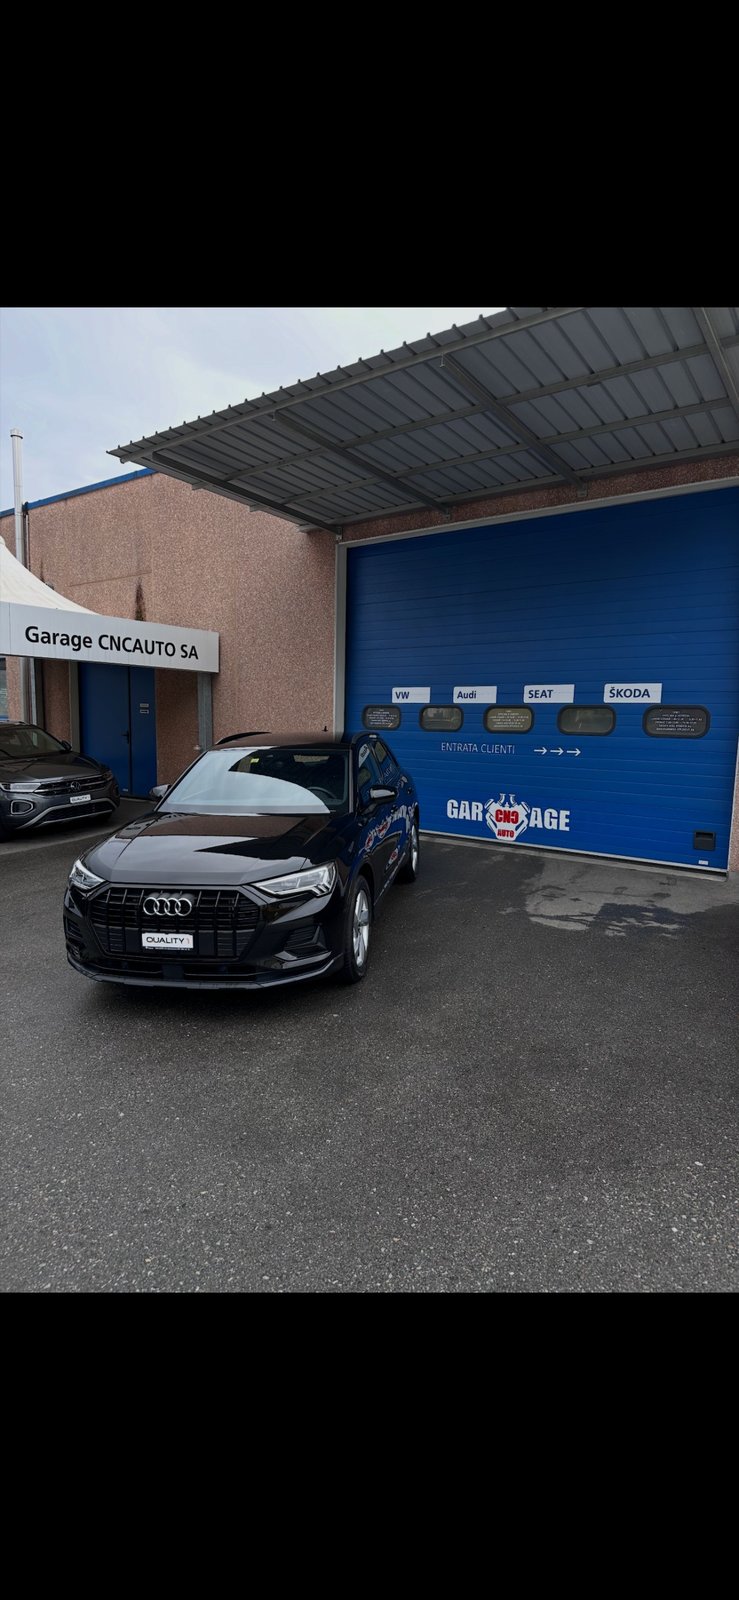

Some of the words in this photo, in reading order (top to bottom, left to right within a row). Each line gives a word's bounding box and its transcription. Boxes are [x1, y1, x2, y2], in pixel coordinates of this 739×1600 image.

[25, 625, 93, 651] Garage
[98, 634, 176, 657] CNCAUTO
[180, 644, 199, 660] SA
[395, 691, 410, 700] VW
[456, 690, 477, 700] Audi
[528, 689, 554, 699] SEAT
[609, 686, 651, 699] ŠKODA
[441, 743, 478, 754] ENTRATA
[481, 744, 516, 755] CLIENTI
[497, 829, 515, 838] AUTO
[146, 936, 185, 944] QUALITY
